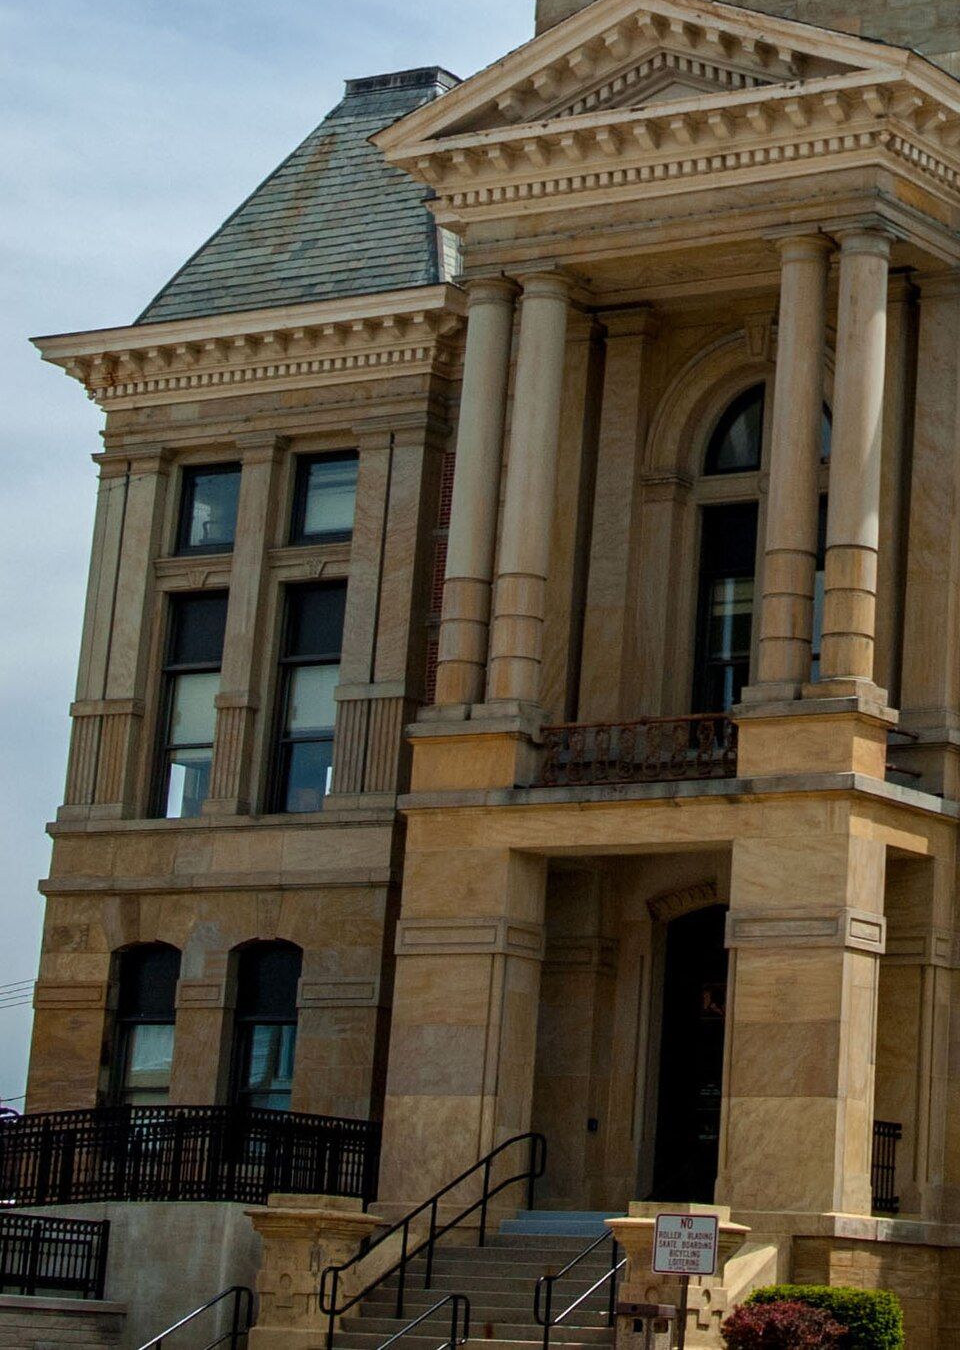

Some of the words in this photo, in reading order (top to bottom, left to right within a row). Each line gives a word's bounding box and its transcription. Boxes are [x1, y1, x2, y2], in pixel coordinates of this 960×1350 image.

[681, 1218, 693, 1229] NO
[659, 1231, 681, 1239] ROLLER
[688, 1232, 713, 1240] BLADING
[659, 1240, 676, 1248] SKATE
